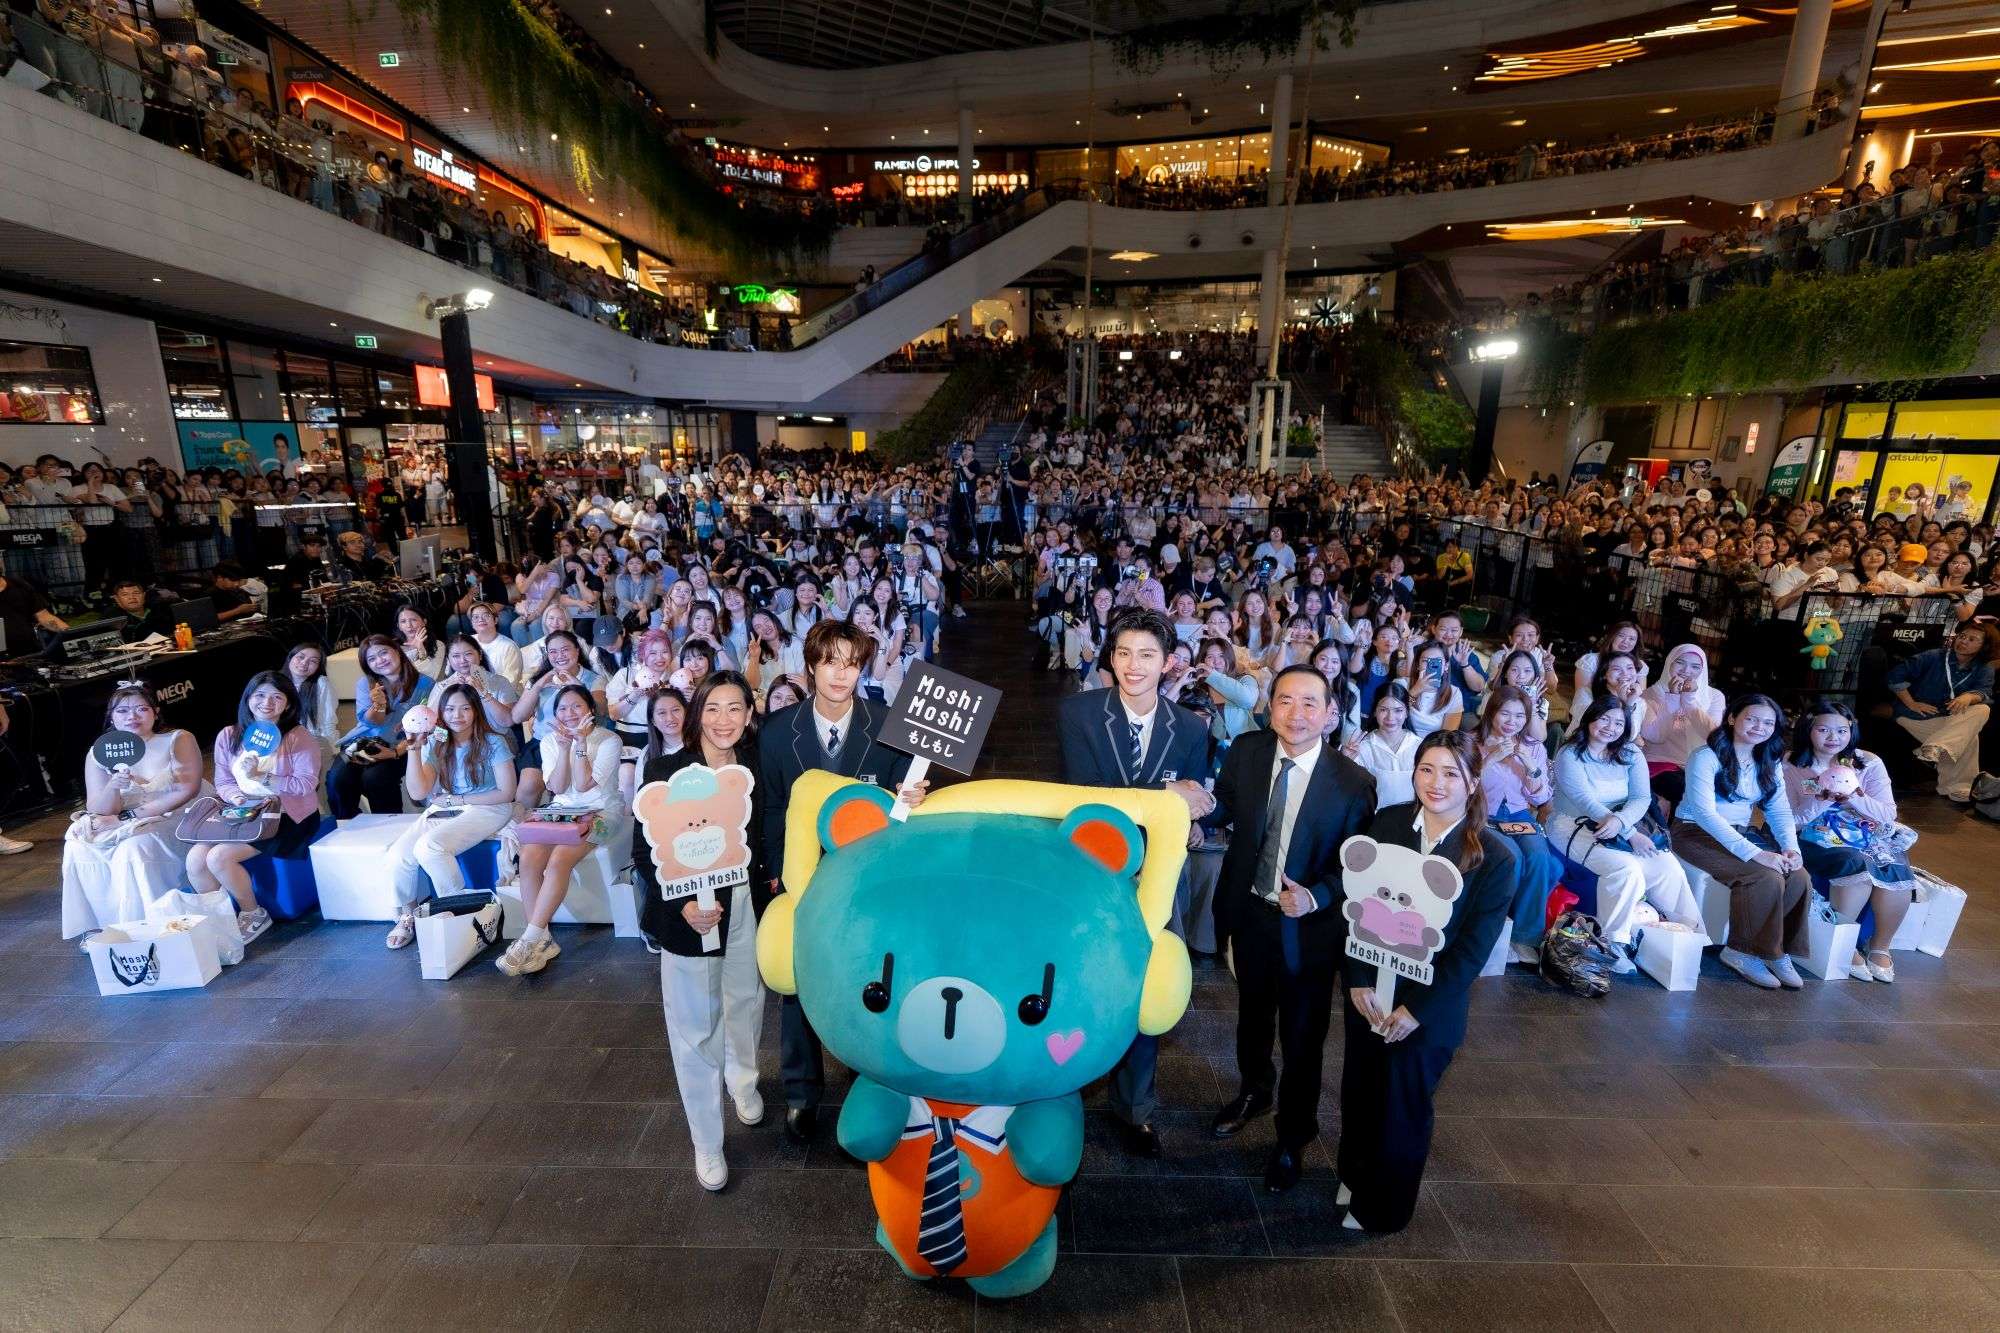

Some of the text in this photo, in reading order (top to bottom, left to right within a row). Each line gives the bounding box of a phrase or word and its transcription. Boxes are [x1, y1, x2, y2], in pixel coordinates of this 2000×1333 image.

[441, 148, 454, 164] THE
[413, 147, 444, 177] STEAK
[451, 165, 477, 191] MORE
[874, 160, 916, 170] RAMEN
[1169, 161, 1201, 175] yuzu
[1771, 477, 1801, 487] FIRST
[12, 533, 43, 545] MEGA
[1892, 629, 1925, 642] MEGA
[156, 679, 195, 702] MEGA
[917, 674, 983, 714] Moshi
[907, 695, 974, 735] Moshi
[105, 741, 134, 751] Moshi
[908, 730, 954, 758] もしもし
[105, 749, 135, 759] Moshi
[666, 868, 744, 897] Moshi Moshi
[1350, 940, 1429, 981] Moshi Moshi
